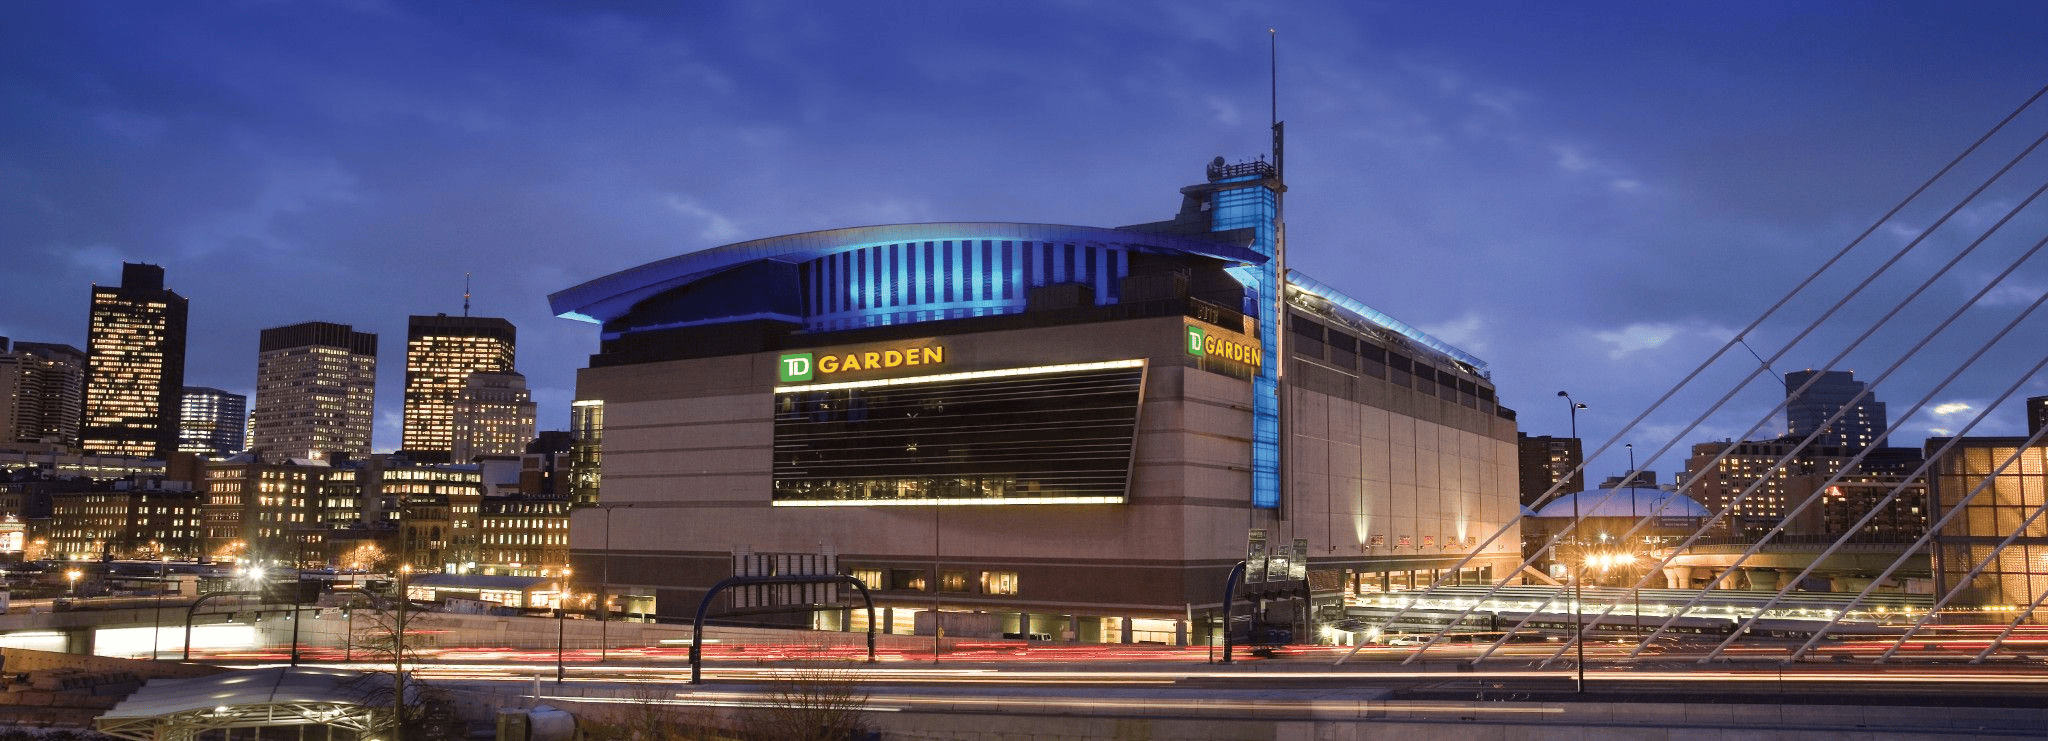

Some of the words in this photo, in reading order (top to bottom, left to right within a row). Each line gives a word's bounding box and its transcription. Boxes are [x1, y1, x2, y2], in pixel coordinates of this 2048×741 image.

[783, 357, 810, 377] TD
[818, 346, 943, 373] GARDEN
[1189, 331, 1202, 351] TD
[1205, 335, 1261, 367] GARDEN
